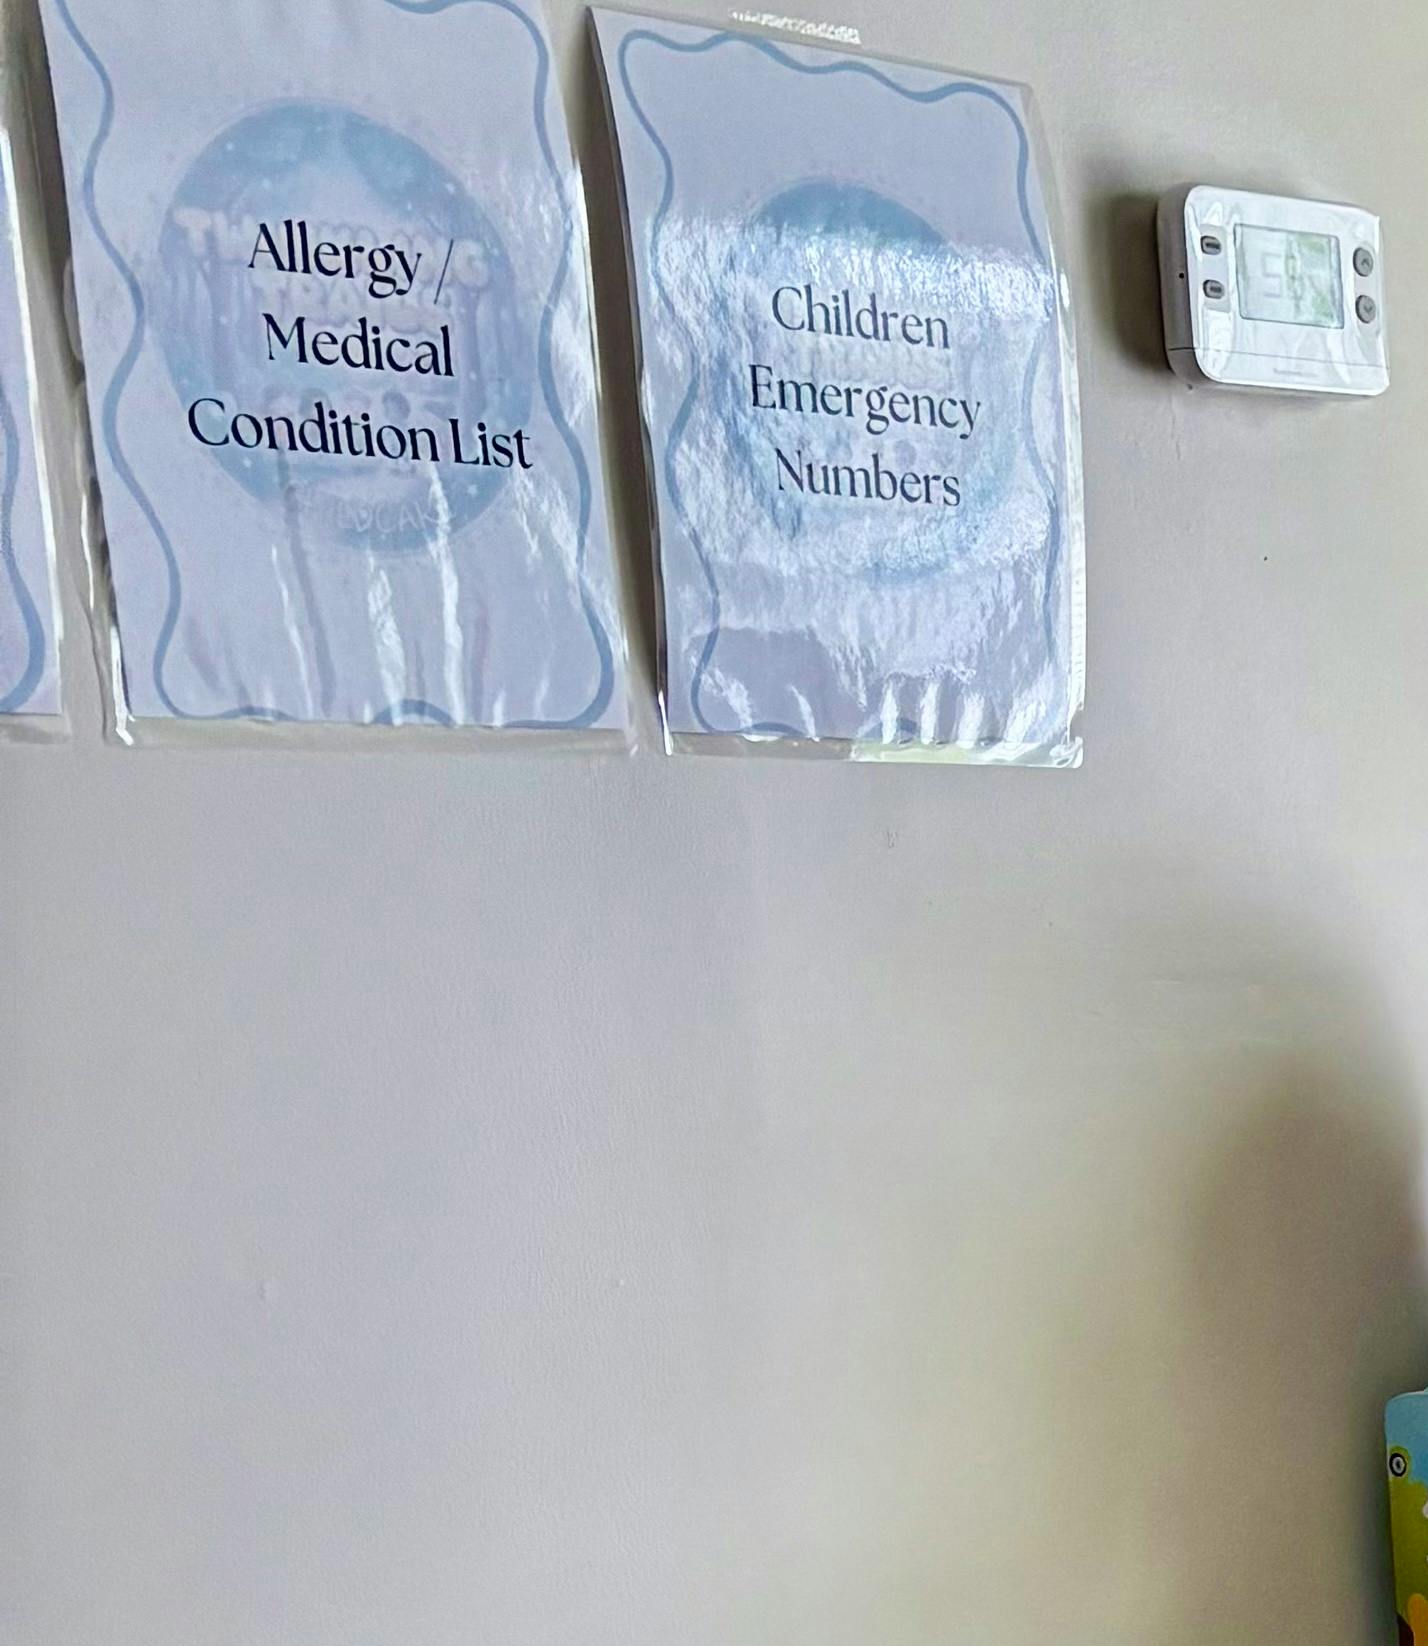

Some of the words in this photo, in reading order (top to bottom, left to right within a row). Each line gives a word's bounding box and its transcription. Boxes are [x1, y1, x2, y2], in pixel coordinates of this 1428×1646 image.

[248, 219, 422, 298] Allergy
[262, 313, 455, 377] Medical
[772, 284, 951, 349] Children
[188, 397, 441, 462] Condition
[449, 418, 533, 469] List
[748, 364, 981, 440] Emergency
[775, 447, 961, 507] Numbers
